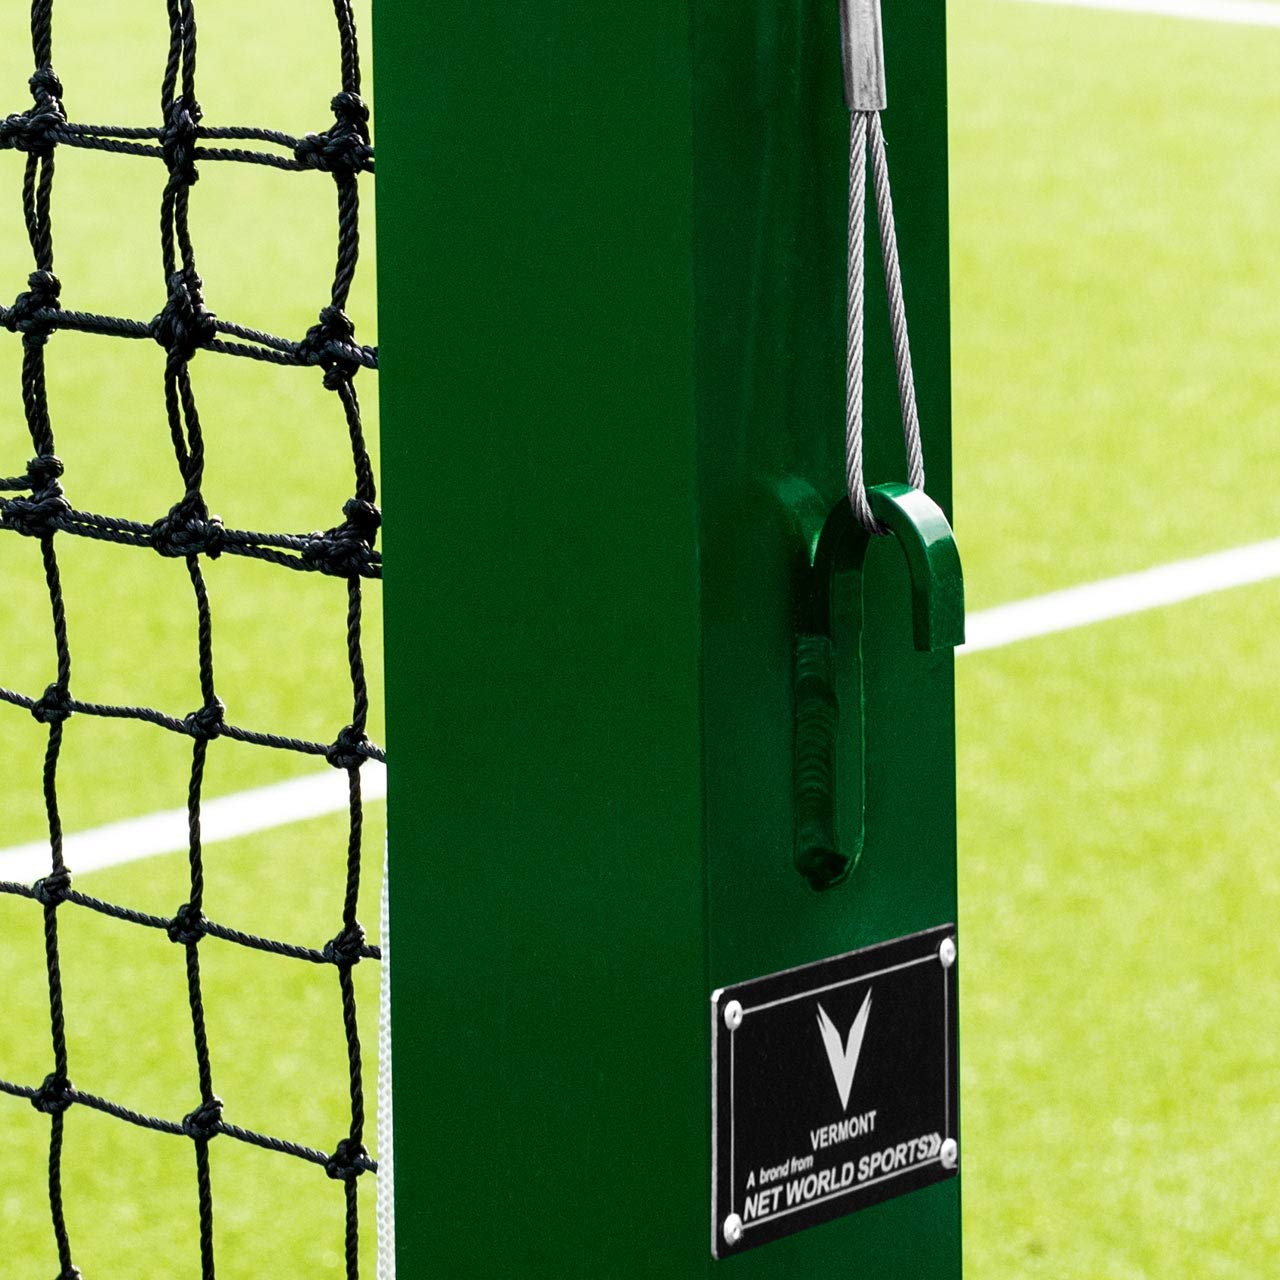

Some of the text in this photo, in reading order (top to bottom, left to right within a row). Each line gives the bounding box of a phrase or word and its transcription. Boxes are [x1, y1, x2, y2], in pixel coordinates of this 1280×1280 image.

[810, 1110, 877, 1151] VERMONT
[743, 1185, 783, 1222] NET
[786, 1161, 854, 1206] WORLD
[746, 1170, 755, 1190] A
[791, 1155, 814, 1174] from
